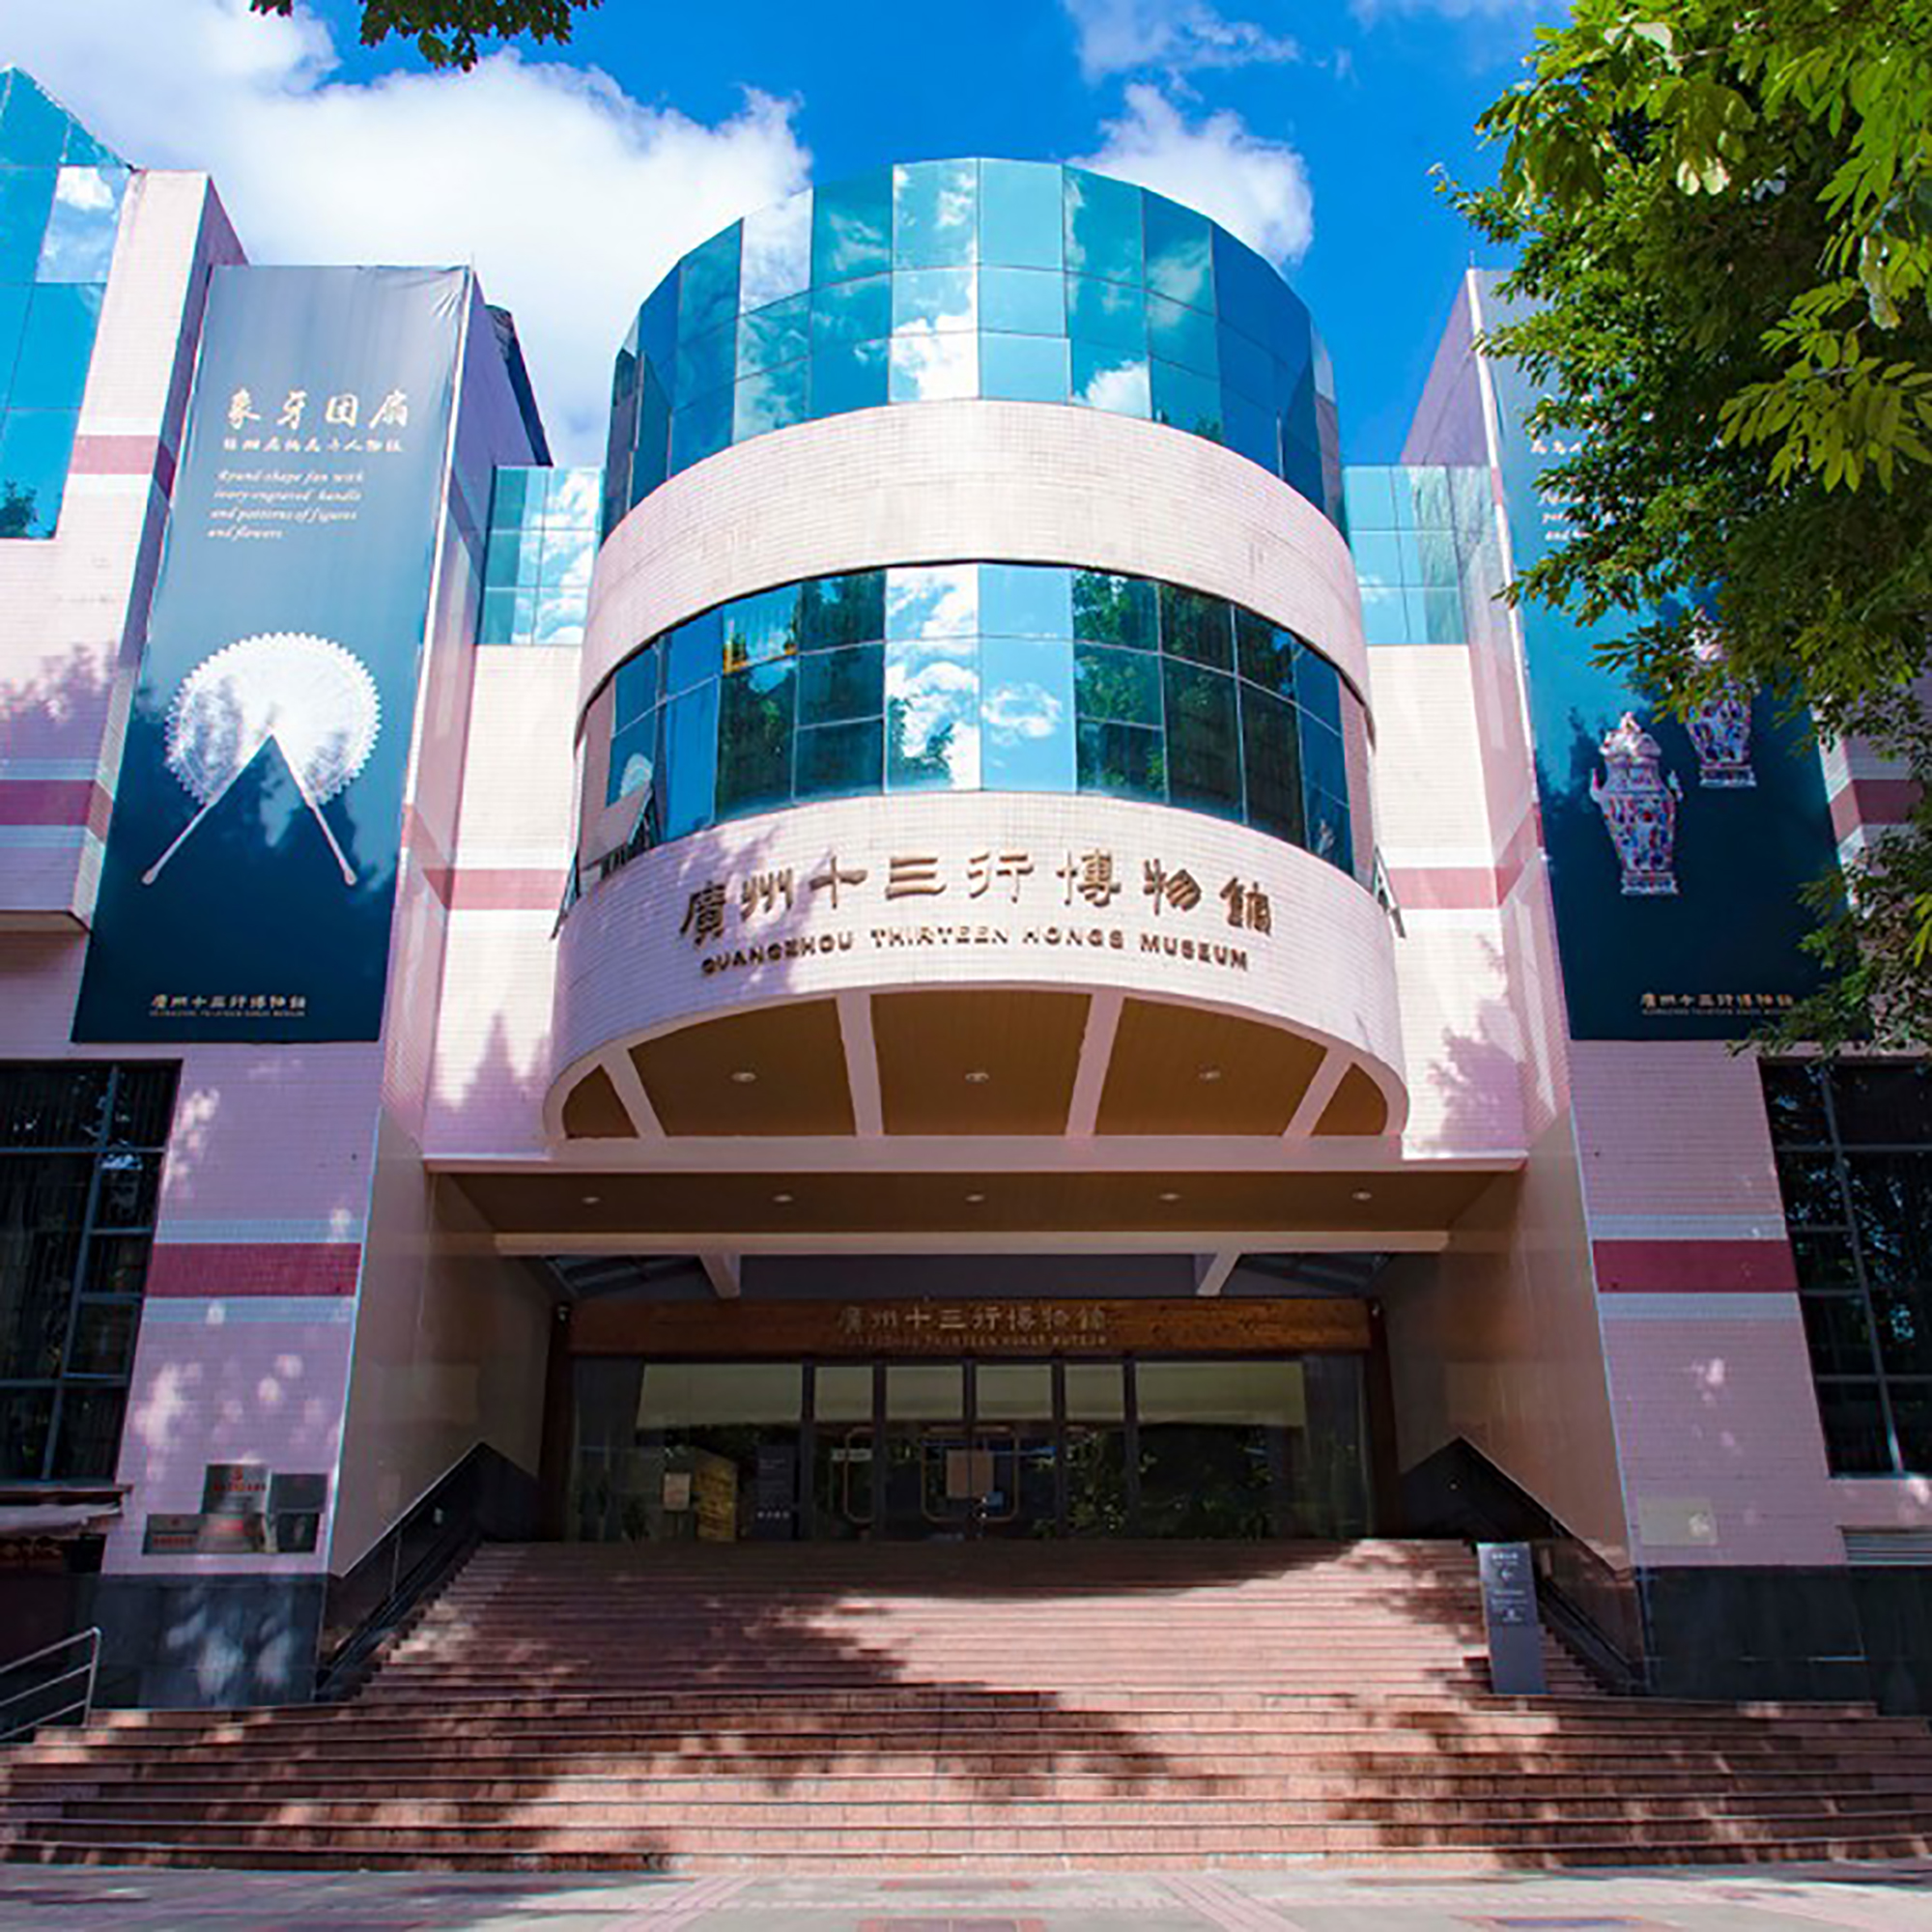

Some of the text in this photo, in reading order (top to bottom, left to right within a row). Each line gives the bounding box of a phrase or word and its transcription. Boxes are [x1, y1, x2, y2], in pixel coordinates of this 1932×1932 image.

[679, 847, 1272, 948] 廣州十三行博物館
[701, 924, 1249, 976] GUANGZHOU THIRTEEN HONGS MUSEUM
